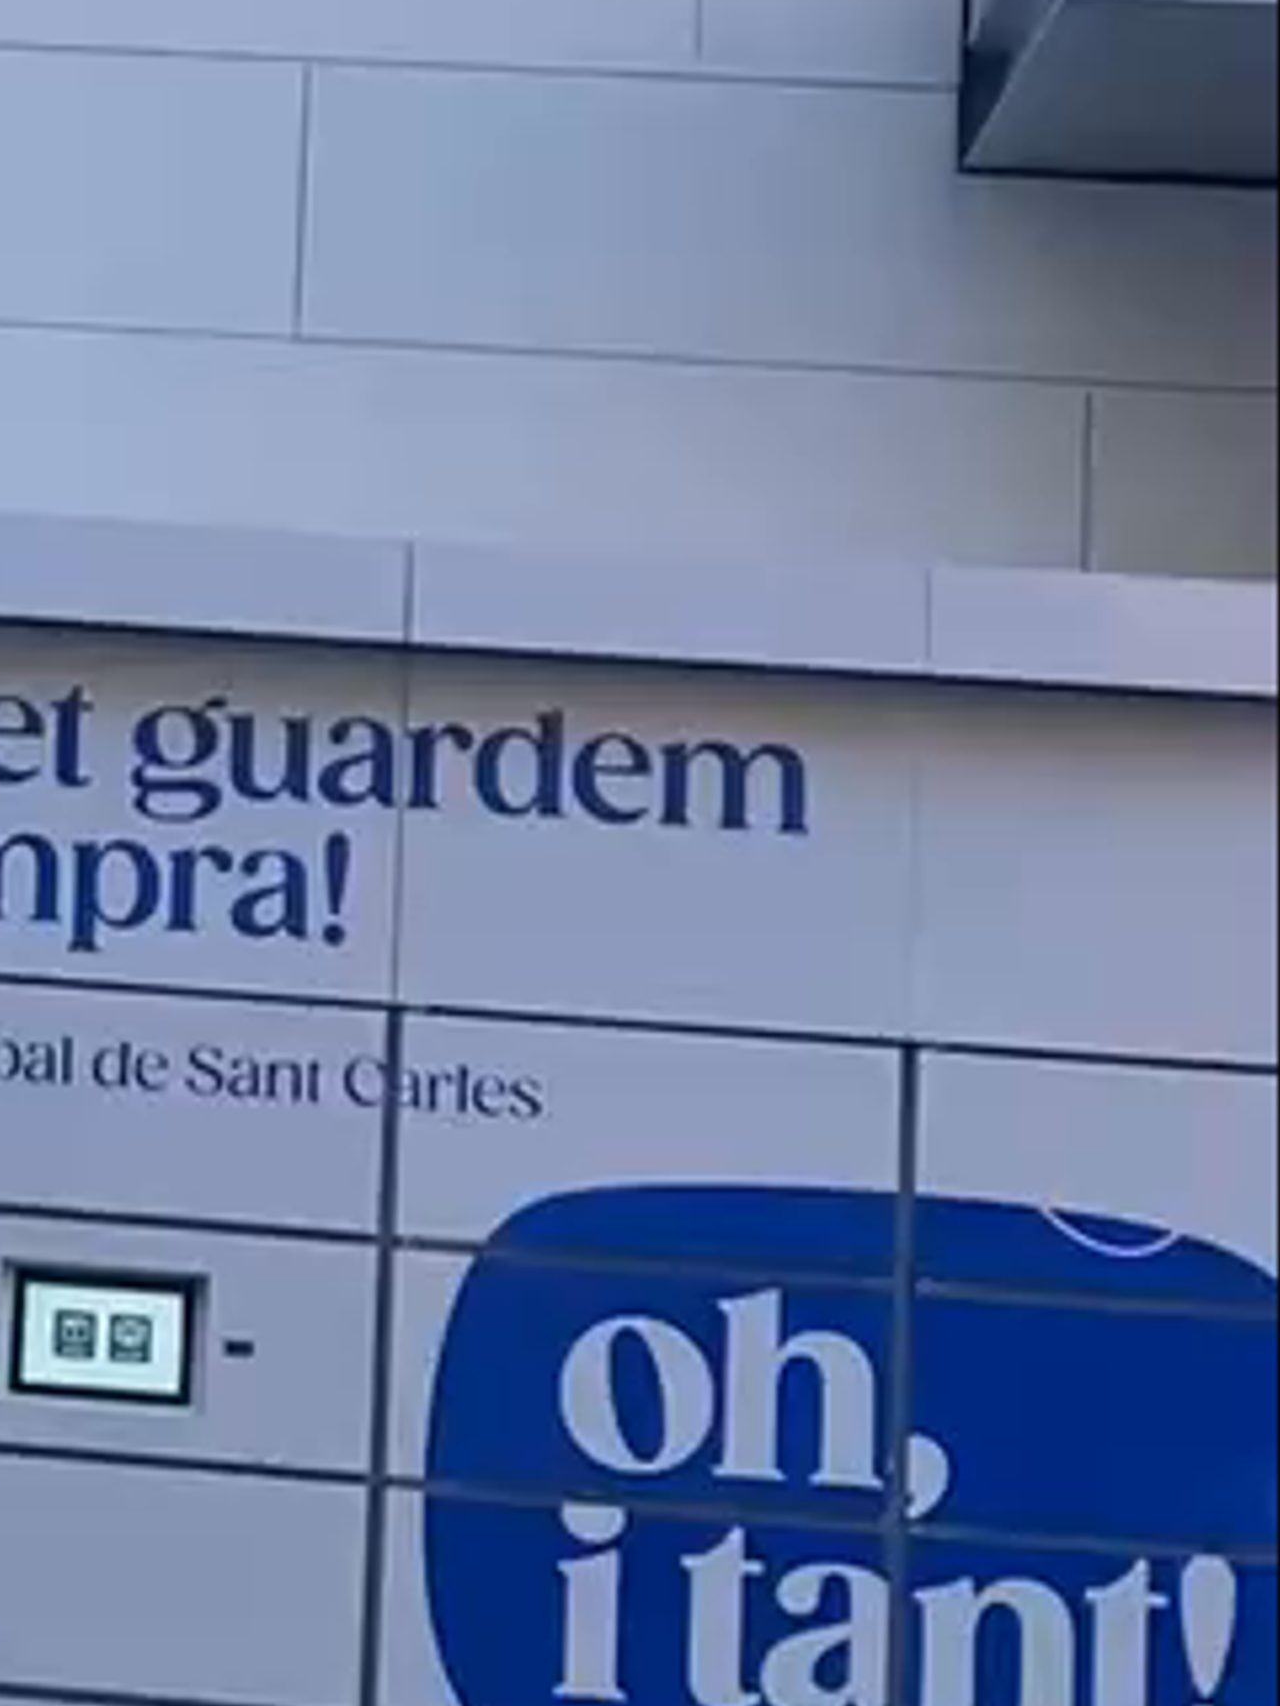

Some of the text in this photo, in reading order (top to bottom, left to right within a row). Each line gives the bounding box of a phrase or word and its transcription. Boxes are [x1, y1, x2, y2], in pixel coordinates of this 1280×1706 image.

[130, 697, 809, 836] guardem
[91, 1040, 170, 1093] de
[185, 1044, 322, 1104] Sant
[342, 1053, 544, 1120] Carles
[558, 1288, 950, 1521] oh,
[551, 1499, 629, 1704] i
